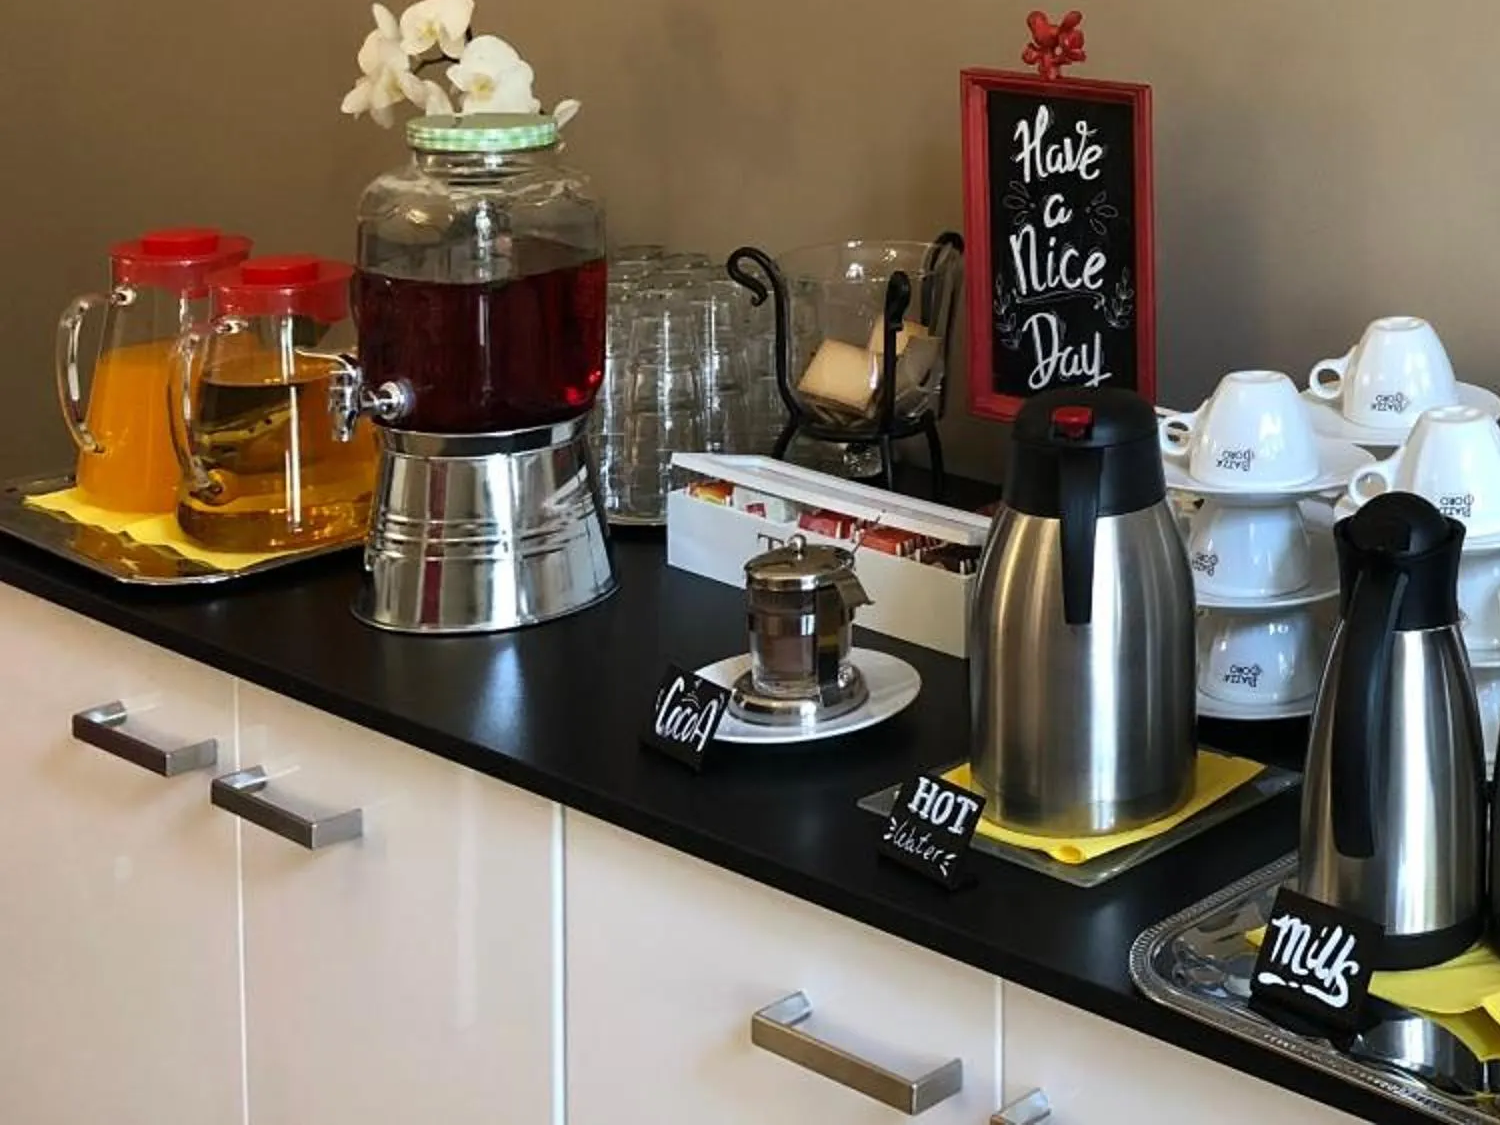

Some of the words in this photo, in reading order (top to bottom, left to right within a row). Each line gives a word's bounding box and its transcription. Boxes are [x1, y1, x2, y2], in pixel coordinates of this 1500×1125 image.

[1012, 104, 1104, 183] Have
[1043, 193, 1073, 229] a
[1009, 223, 1107, 295] Nice
[1022, 313, 1112, 390] Day
[1440, 506, 1471, 517] PIAZZ
[908, 776, 979, 834] HOT
[893, 819, 945, 862] Water
[1270, 914, 1360, 1007] Milk
